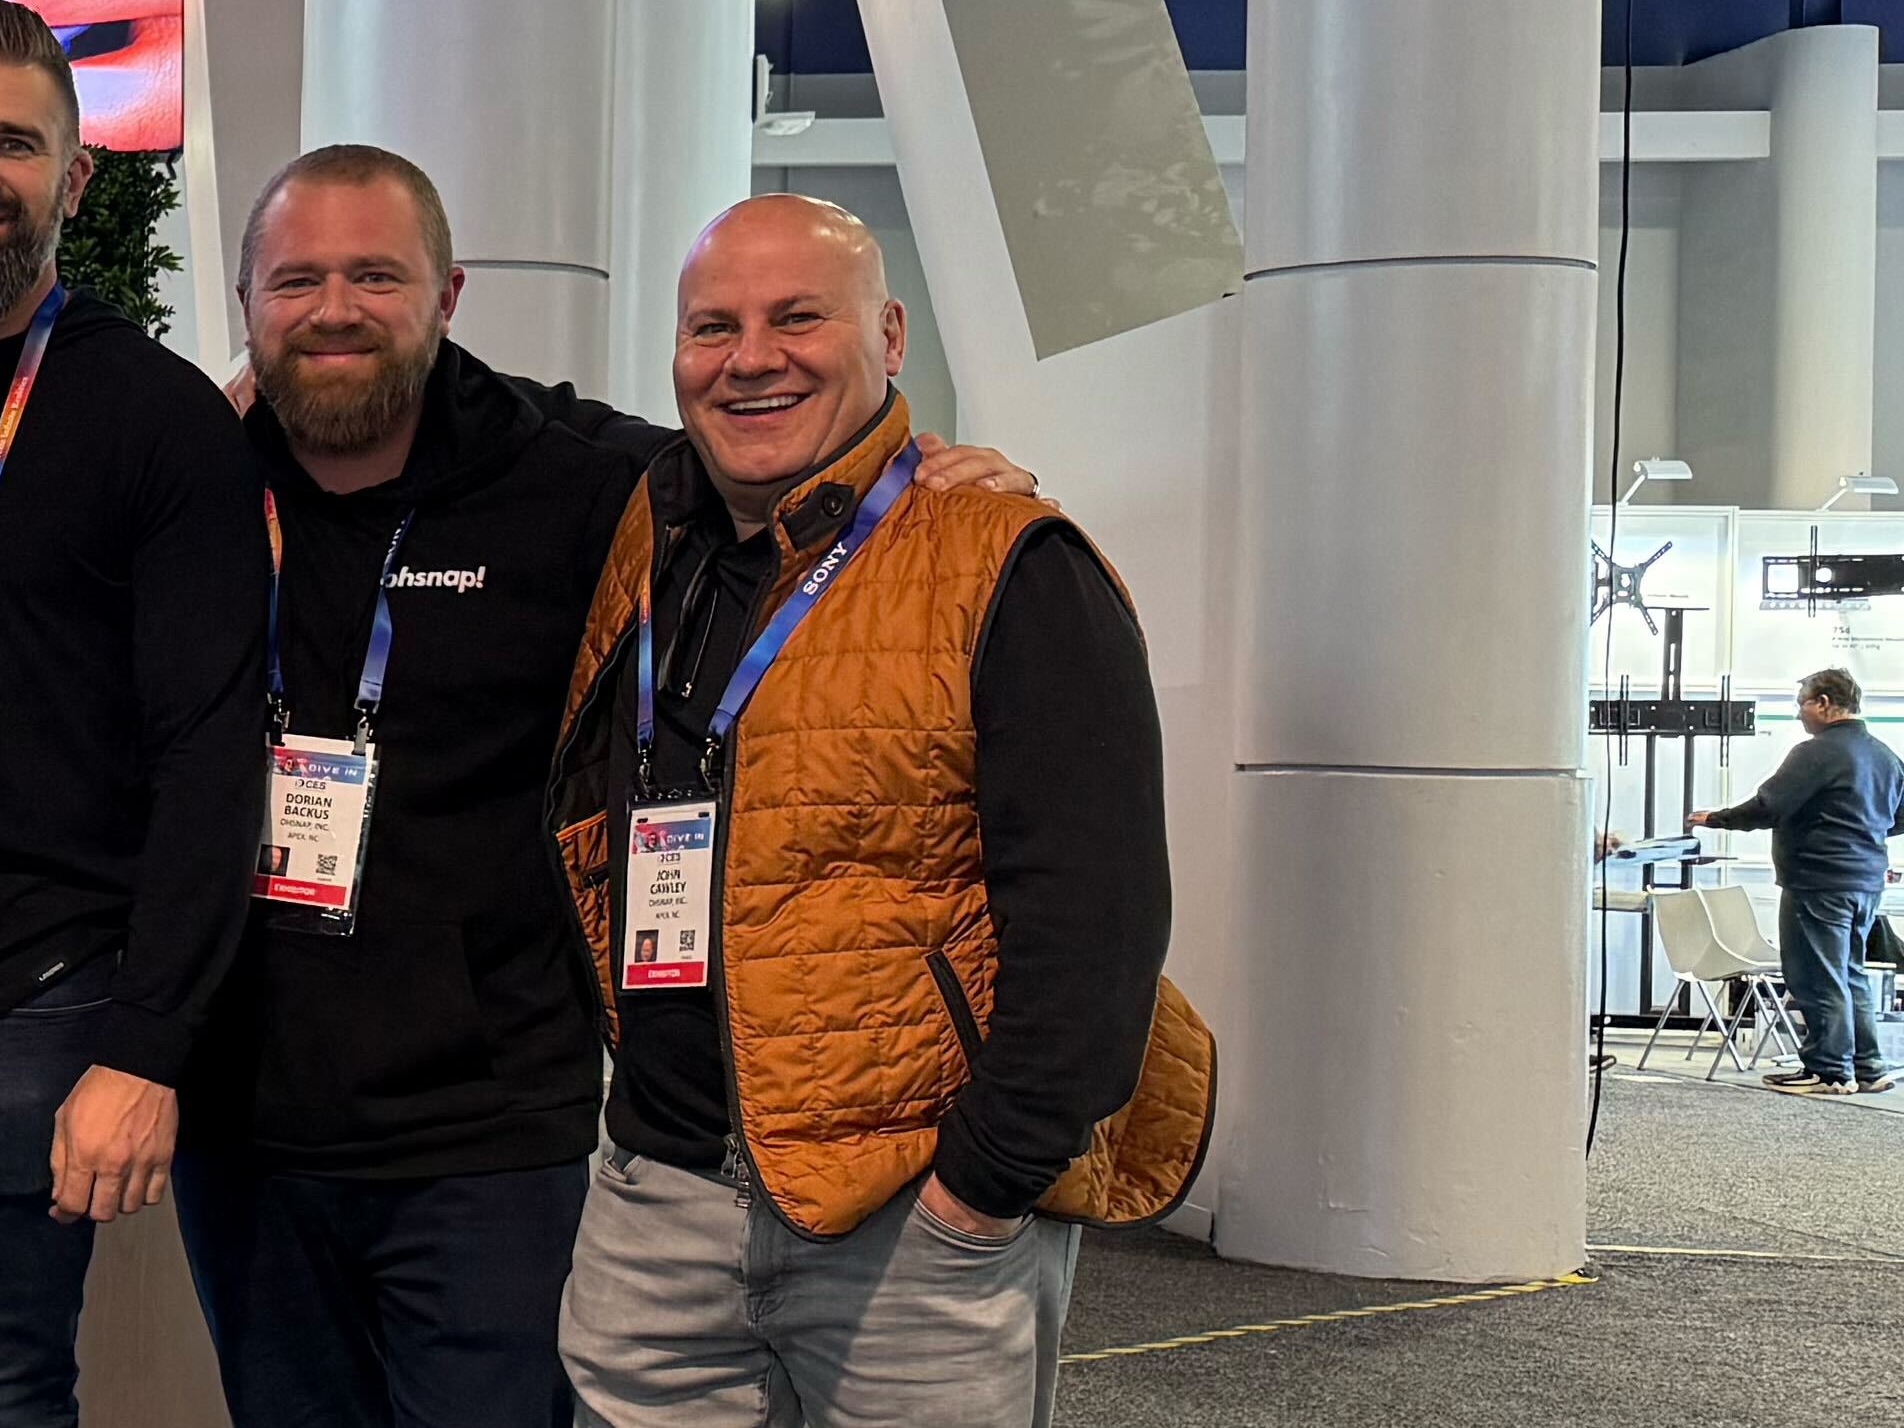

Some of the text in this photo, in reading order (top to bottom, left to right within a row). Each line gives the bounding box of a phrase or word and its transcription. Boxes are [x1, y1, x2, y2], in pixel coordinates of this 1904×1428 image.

[802, 541, 848, 596] SONY
[308, 762, 358, 777] DIVE IN
[305, 780, 327, 790] CES
[285, 792, 333, 809] DORIAN
[283, 805, 330, 821] BACKUS
[656, 868, 681, 882] JOHN
